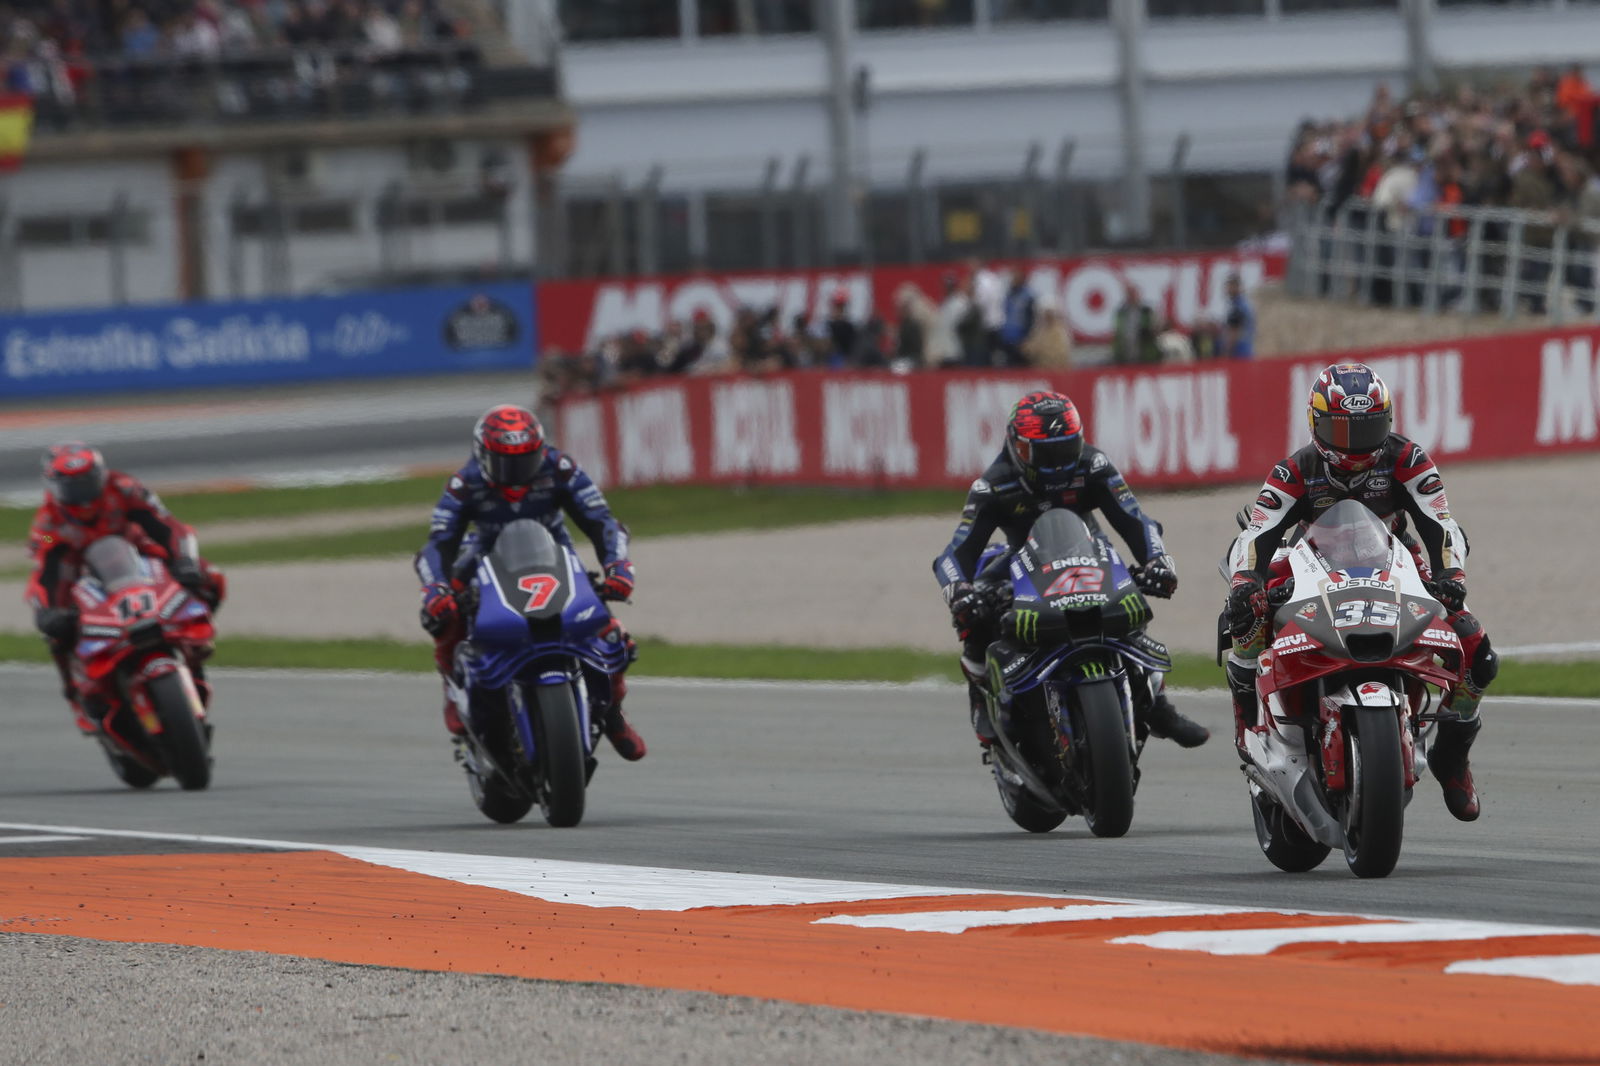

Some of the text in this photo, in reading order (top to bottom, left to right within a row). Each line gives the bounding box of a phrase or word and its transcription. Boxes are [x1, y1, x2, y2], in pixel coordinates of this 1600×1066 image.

[1536, 337, 1600, 445] M
[1343, 397, 1371, 408] Arai
[1093, 370, 1239, 475] MOTUL
[1052, 557, 1099, 570] ENEOS
[1042, 567, 1105, 597] 42
[1326, 579, 1396, 592] CUSTOM
[518, 573, 560, 612] 7
[1050, 593, 1109, 608] MONSTER
[1334, 600, 1400, 629] 35
[1272, 633, 1308, 650] GIVI
[1423, 628, 1457, 642] GIVI
[1277, 644, 1317, 656] HONDA
[1419, 639, 1457, 648] HONDA
